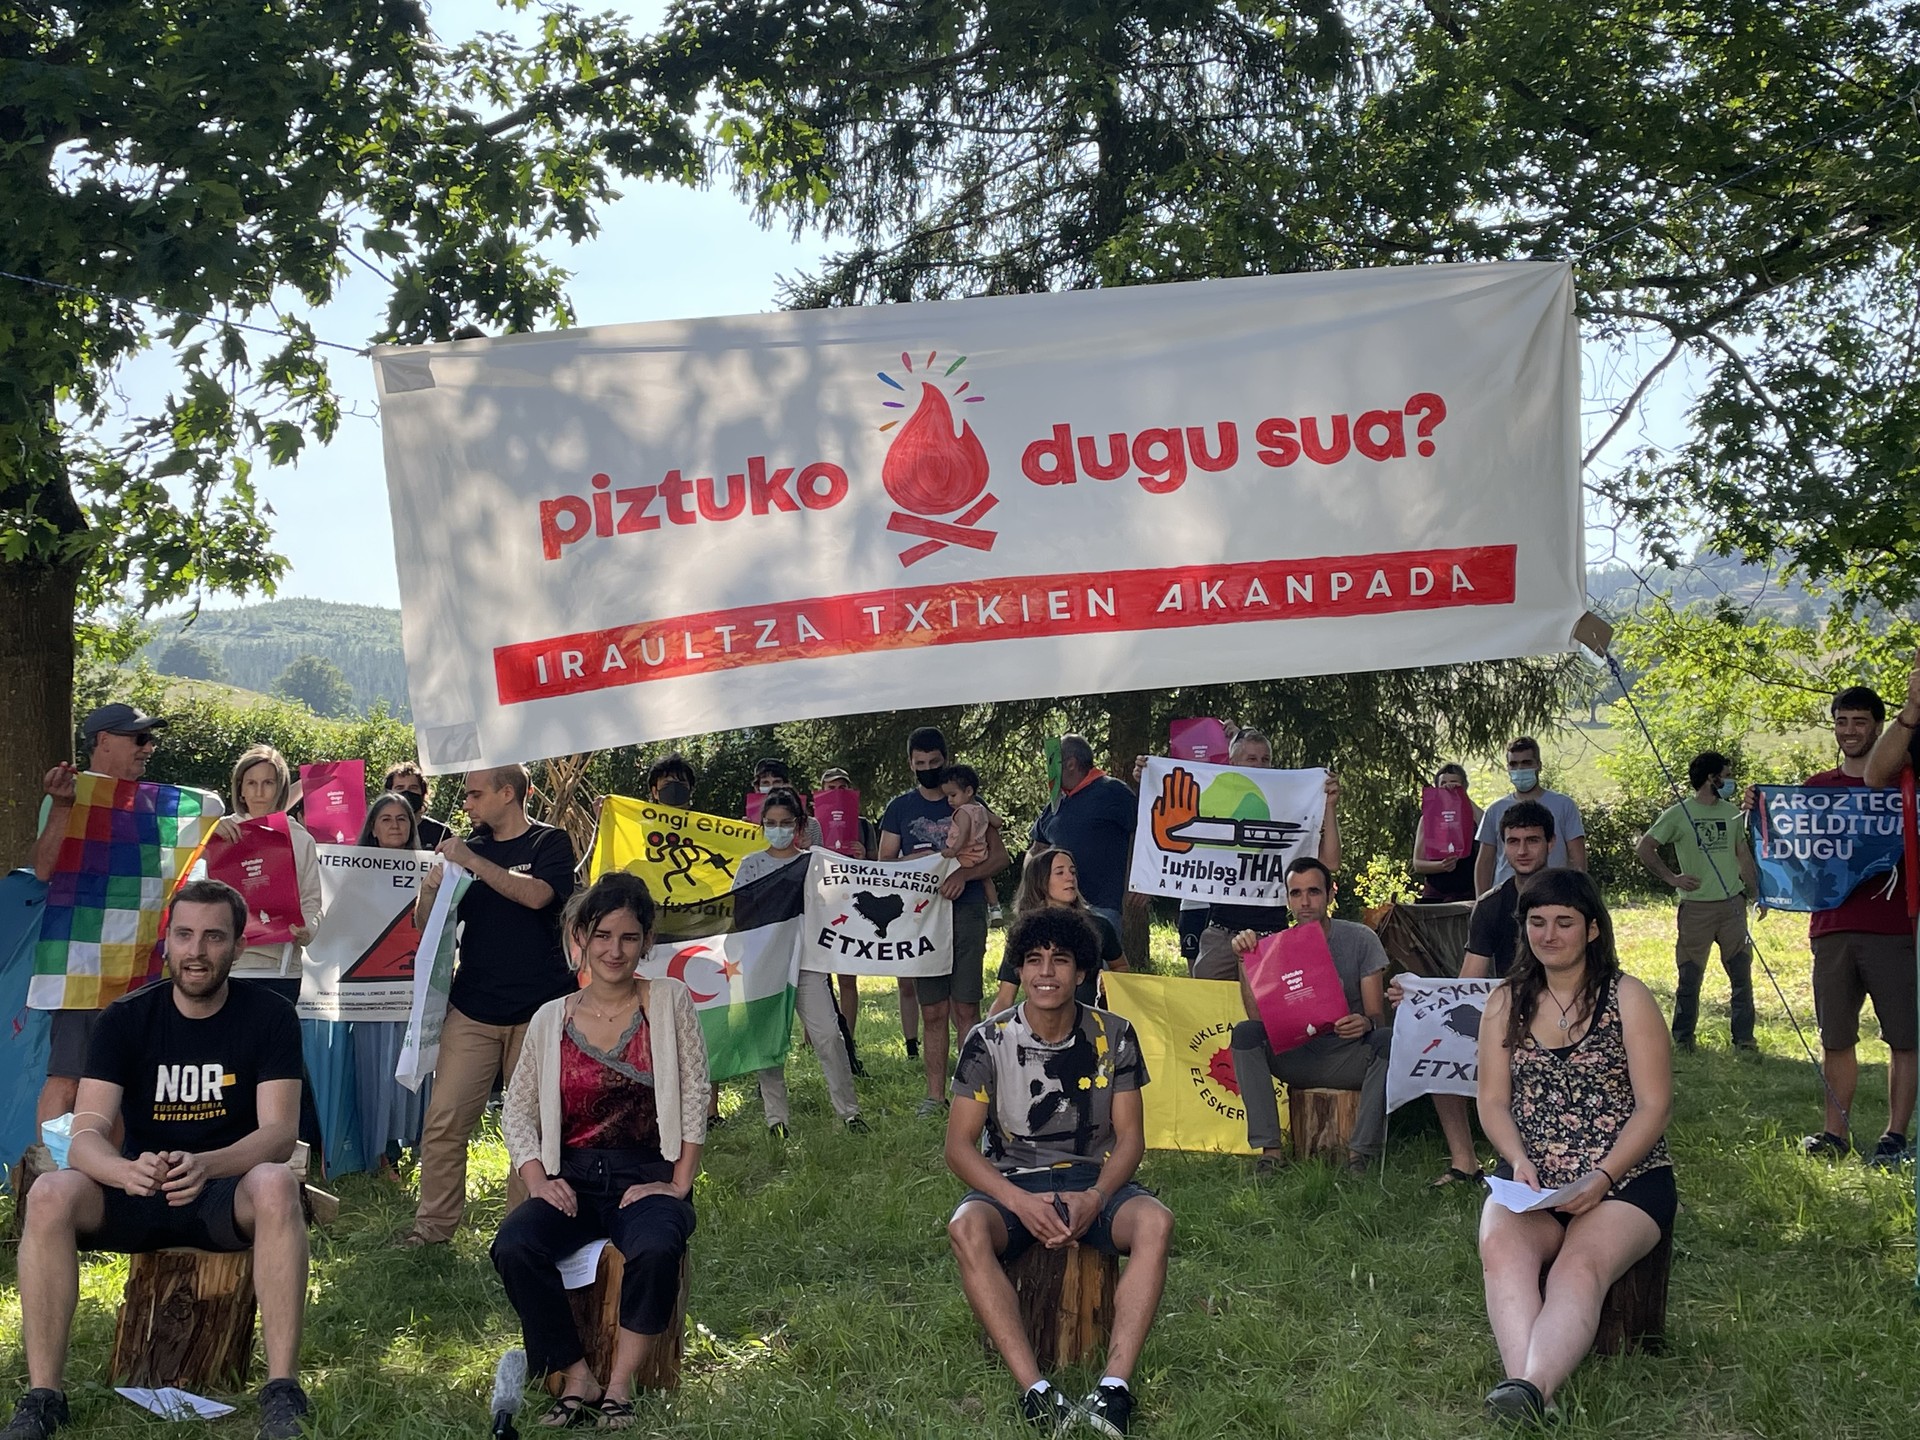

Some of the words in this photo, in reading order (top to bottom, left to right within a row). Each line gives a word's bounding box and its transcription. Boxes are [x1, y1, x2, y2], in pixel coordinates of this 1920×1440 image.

[539, 456, 849, 561] piztuko
[1021, 421, 1239, 494] dugu
[1256, 392, 1447, 468] sua?
[536, 613, 824, 685] IRAULTZA
[862, 586, 1116, 635] TXIKIEN
[1156, 564, 1475, 613] AKANPADA
[1769, 792, 1903, 813] AROZTEG
[1773, 838, 1853, 860] DUGU
[317, 854, 416, 872] NTERKONEXIO
[830, 863, 888, 877] EUSKAL
[894, 870, 940, 885] PRESO
[392, 875, 415, 889] EZ
[823, 875, 850, 886] ETA
[856, 876, 941, 896] IHESLARIAK
[817, 927, 936, 961] ETXERA
[1414, 997, 1450, 1021] ETA
[1189, 1022, 1235, 1053] NUKLEA
[1190, 1067, 1205, 1087] EZ
[1199, 1087, 1245, 1121] ESKER
[152, 1108, 227, 1121] ANTIESPEZISTA
[153, 1103, 187, 1112] EUSKAL
